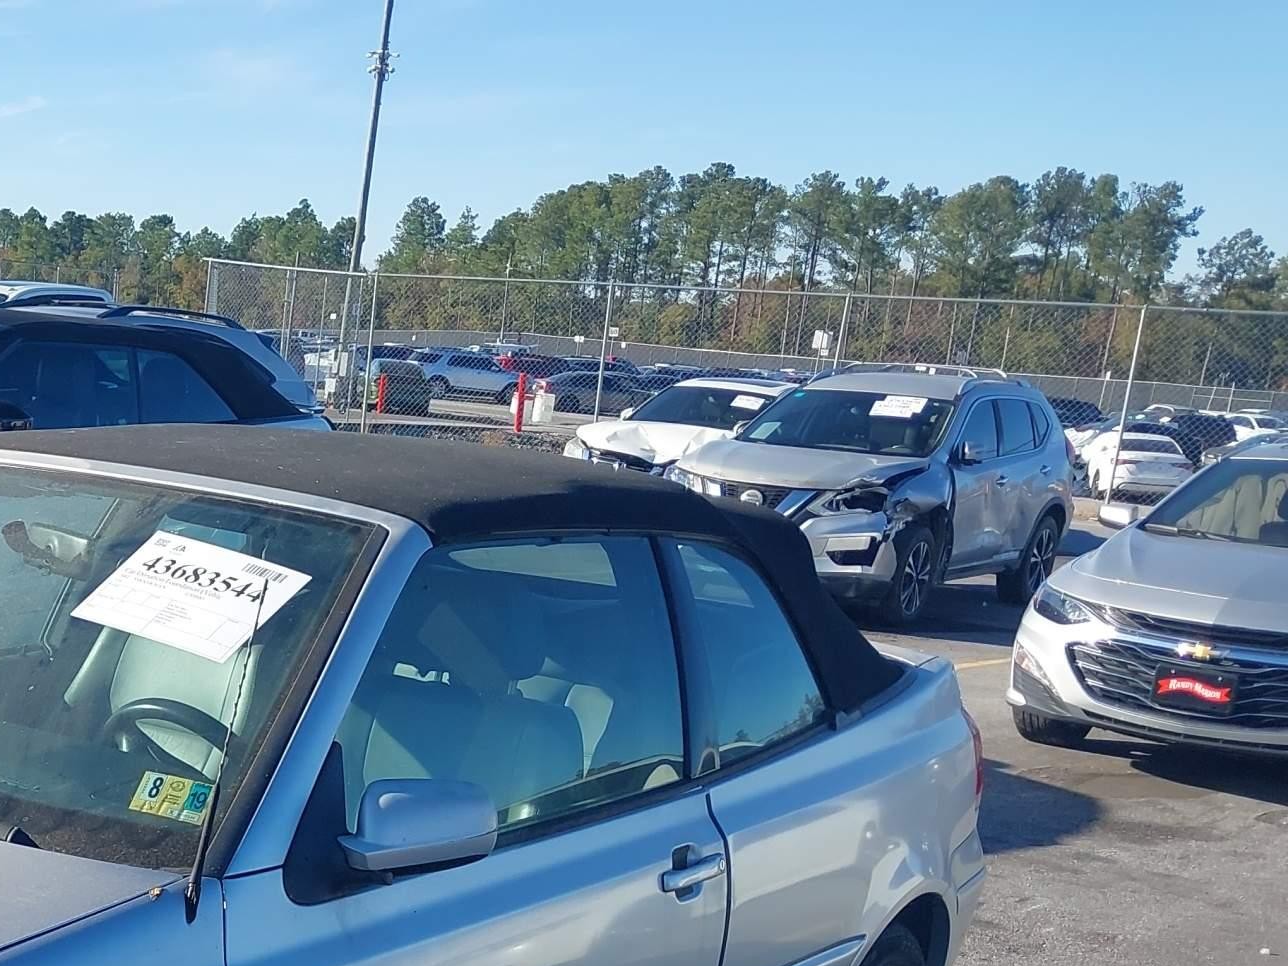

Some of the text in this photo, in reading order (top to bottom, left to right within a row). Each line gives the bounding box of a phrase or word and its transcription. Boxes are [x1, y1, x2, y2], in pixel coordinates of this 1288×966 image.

[141, 555, 263, 604] 43683544
[147, 776, 165, 799] 8
[189, 790, 208, 810] 19
